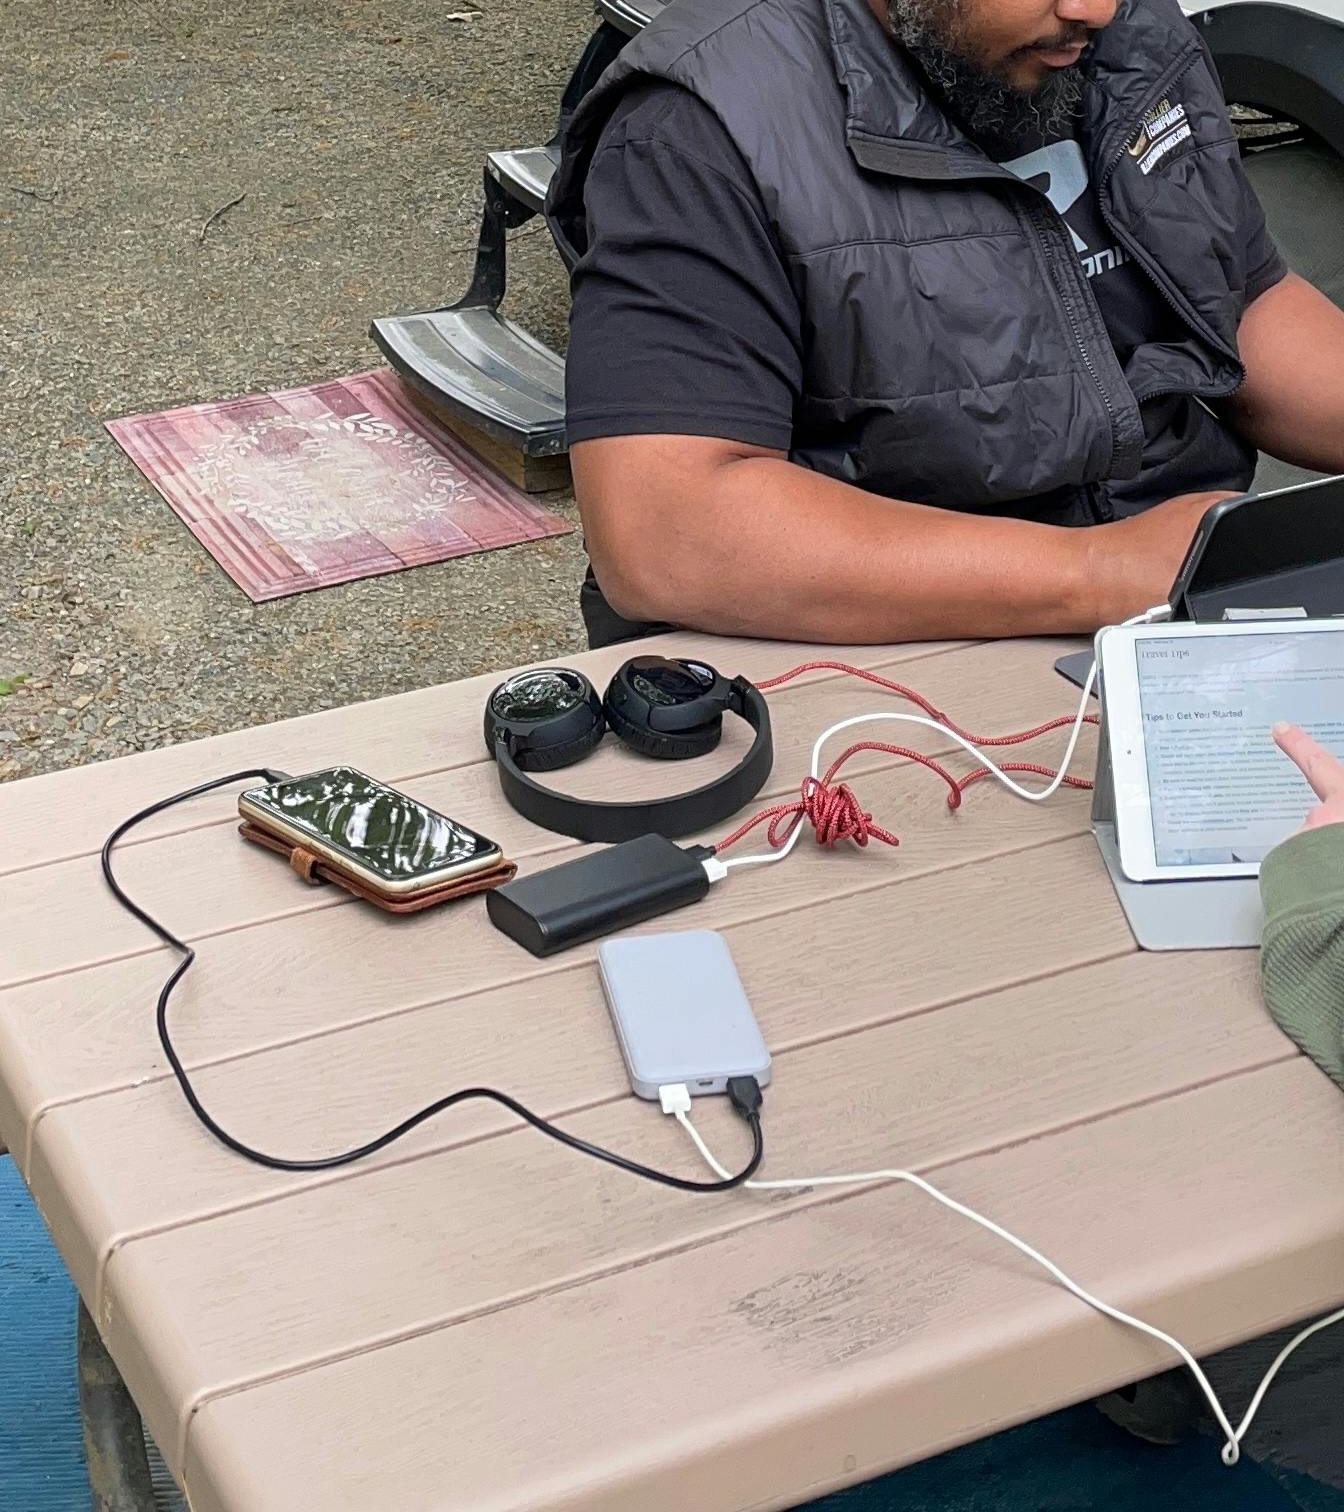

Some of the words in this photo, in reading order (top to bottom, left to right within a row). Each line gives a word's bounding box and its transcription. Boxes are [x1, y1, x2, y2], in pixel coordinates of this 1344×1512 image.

[1145, 713, 1164, 722] Tips
[1177, 711, 1192, 720] Get
[1213, 709, 1243, 719] Started
